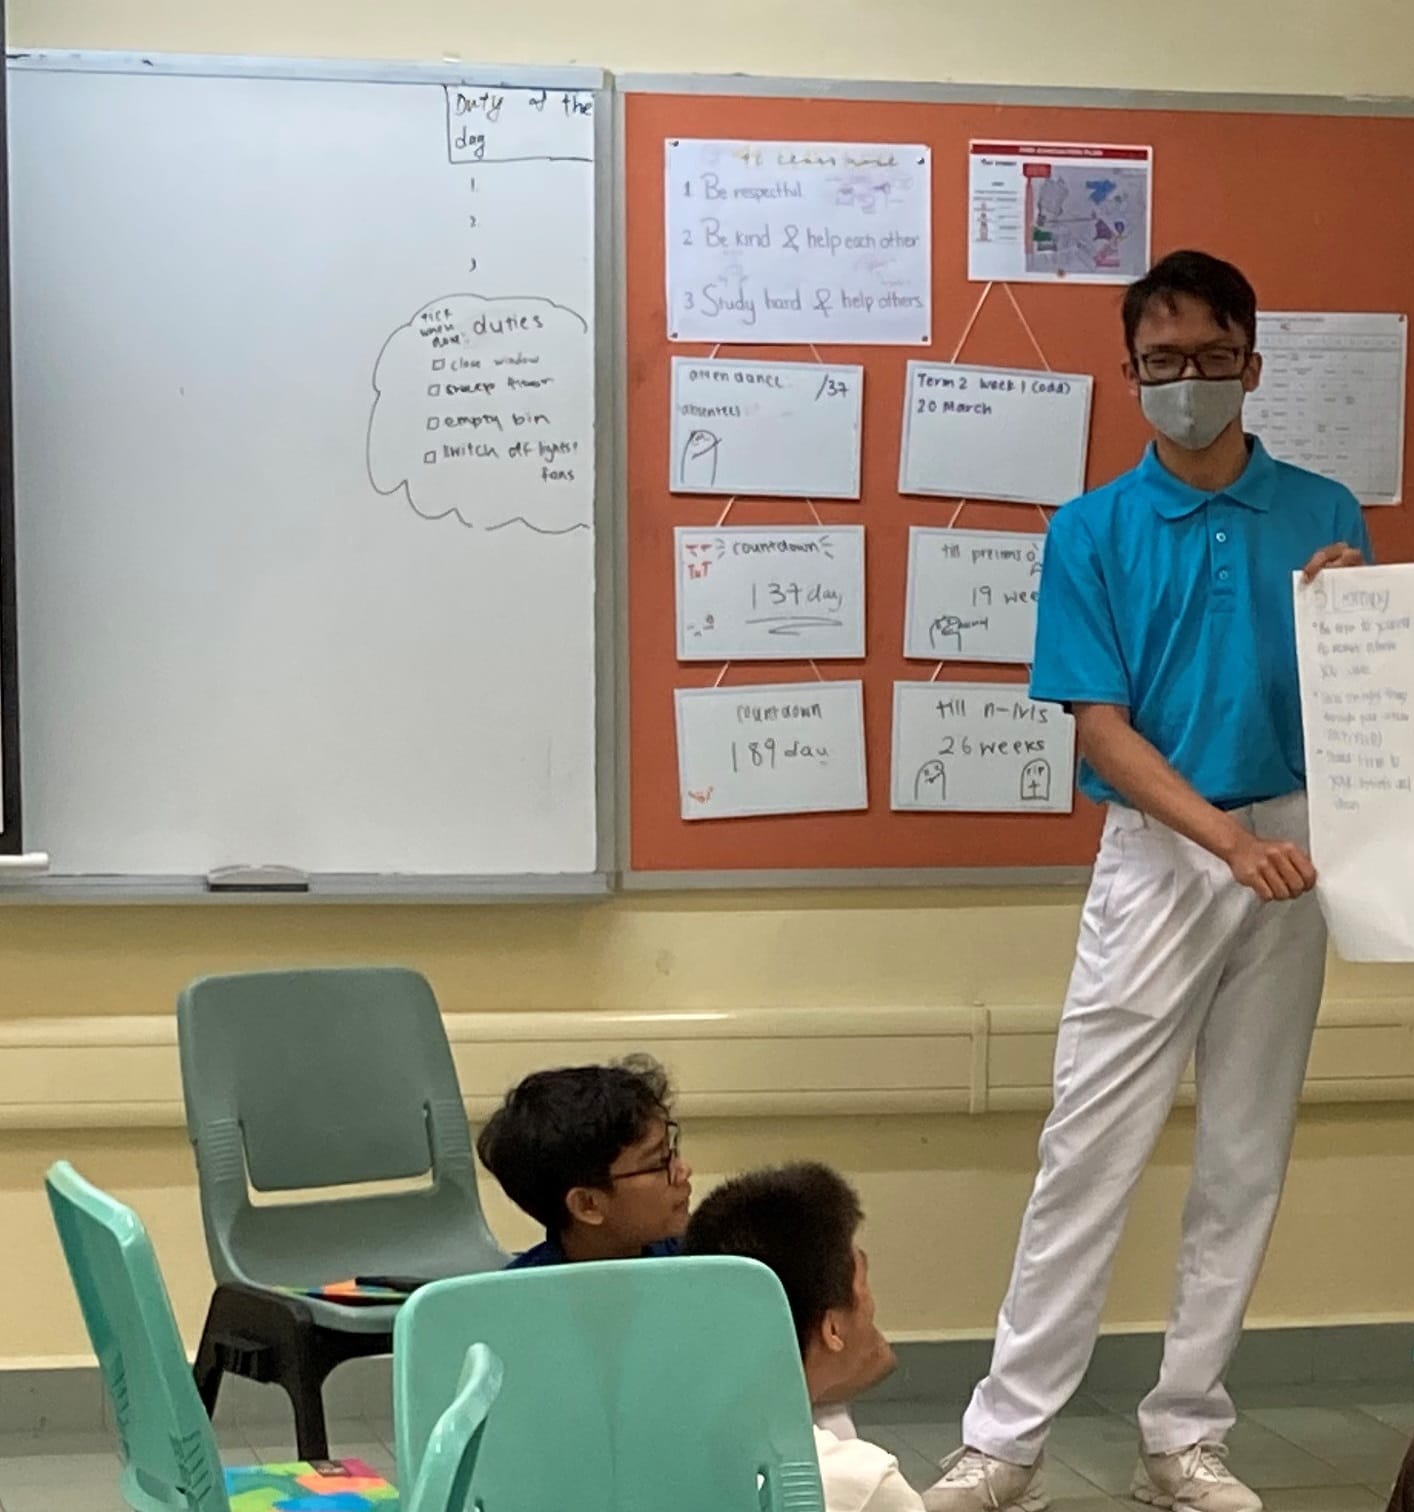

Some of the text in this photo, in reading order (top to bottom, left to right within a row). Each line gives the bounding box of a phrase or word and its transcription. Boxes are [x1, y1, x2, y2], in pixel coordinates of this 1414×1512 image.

[456, 92, 504, 122] Duty
[562, 93, 593, 118] the
[700, 172, 728, 202] Be
[733, 181, 804, 207] respectful
[682, 217, 920, 258] 2 Be kind & help each other
[684, 291, 695, 311] 3
[700, 283, 757, 327] Study
[764, 288, 803, 312] hard
[812, 287, 833, 319] &
[840, 289, 873, 314] help
[472, 314, 544, 335] duties
[494, 352, 540, 366] window
[916, 372, 956, 390] Term
[958, 376, 969, 390] 2
[1031, 379, 1072, 397] (odd)
[916, 398, 993, 416] 20 March
[444, 412, 551, 432] empty bin
[443, 441, 500, 459] switch
[971, 584, 1040, 608] 19 wee
[731, 737, 776, 774] 189
[938, 735, 1046, 757] 26 weeks
